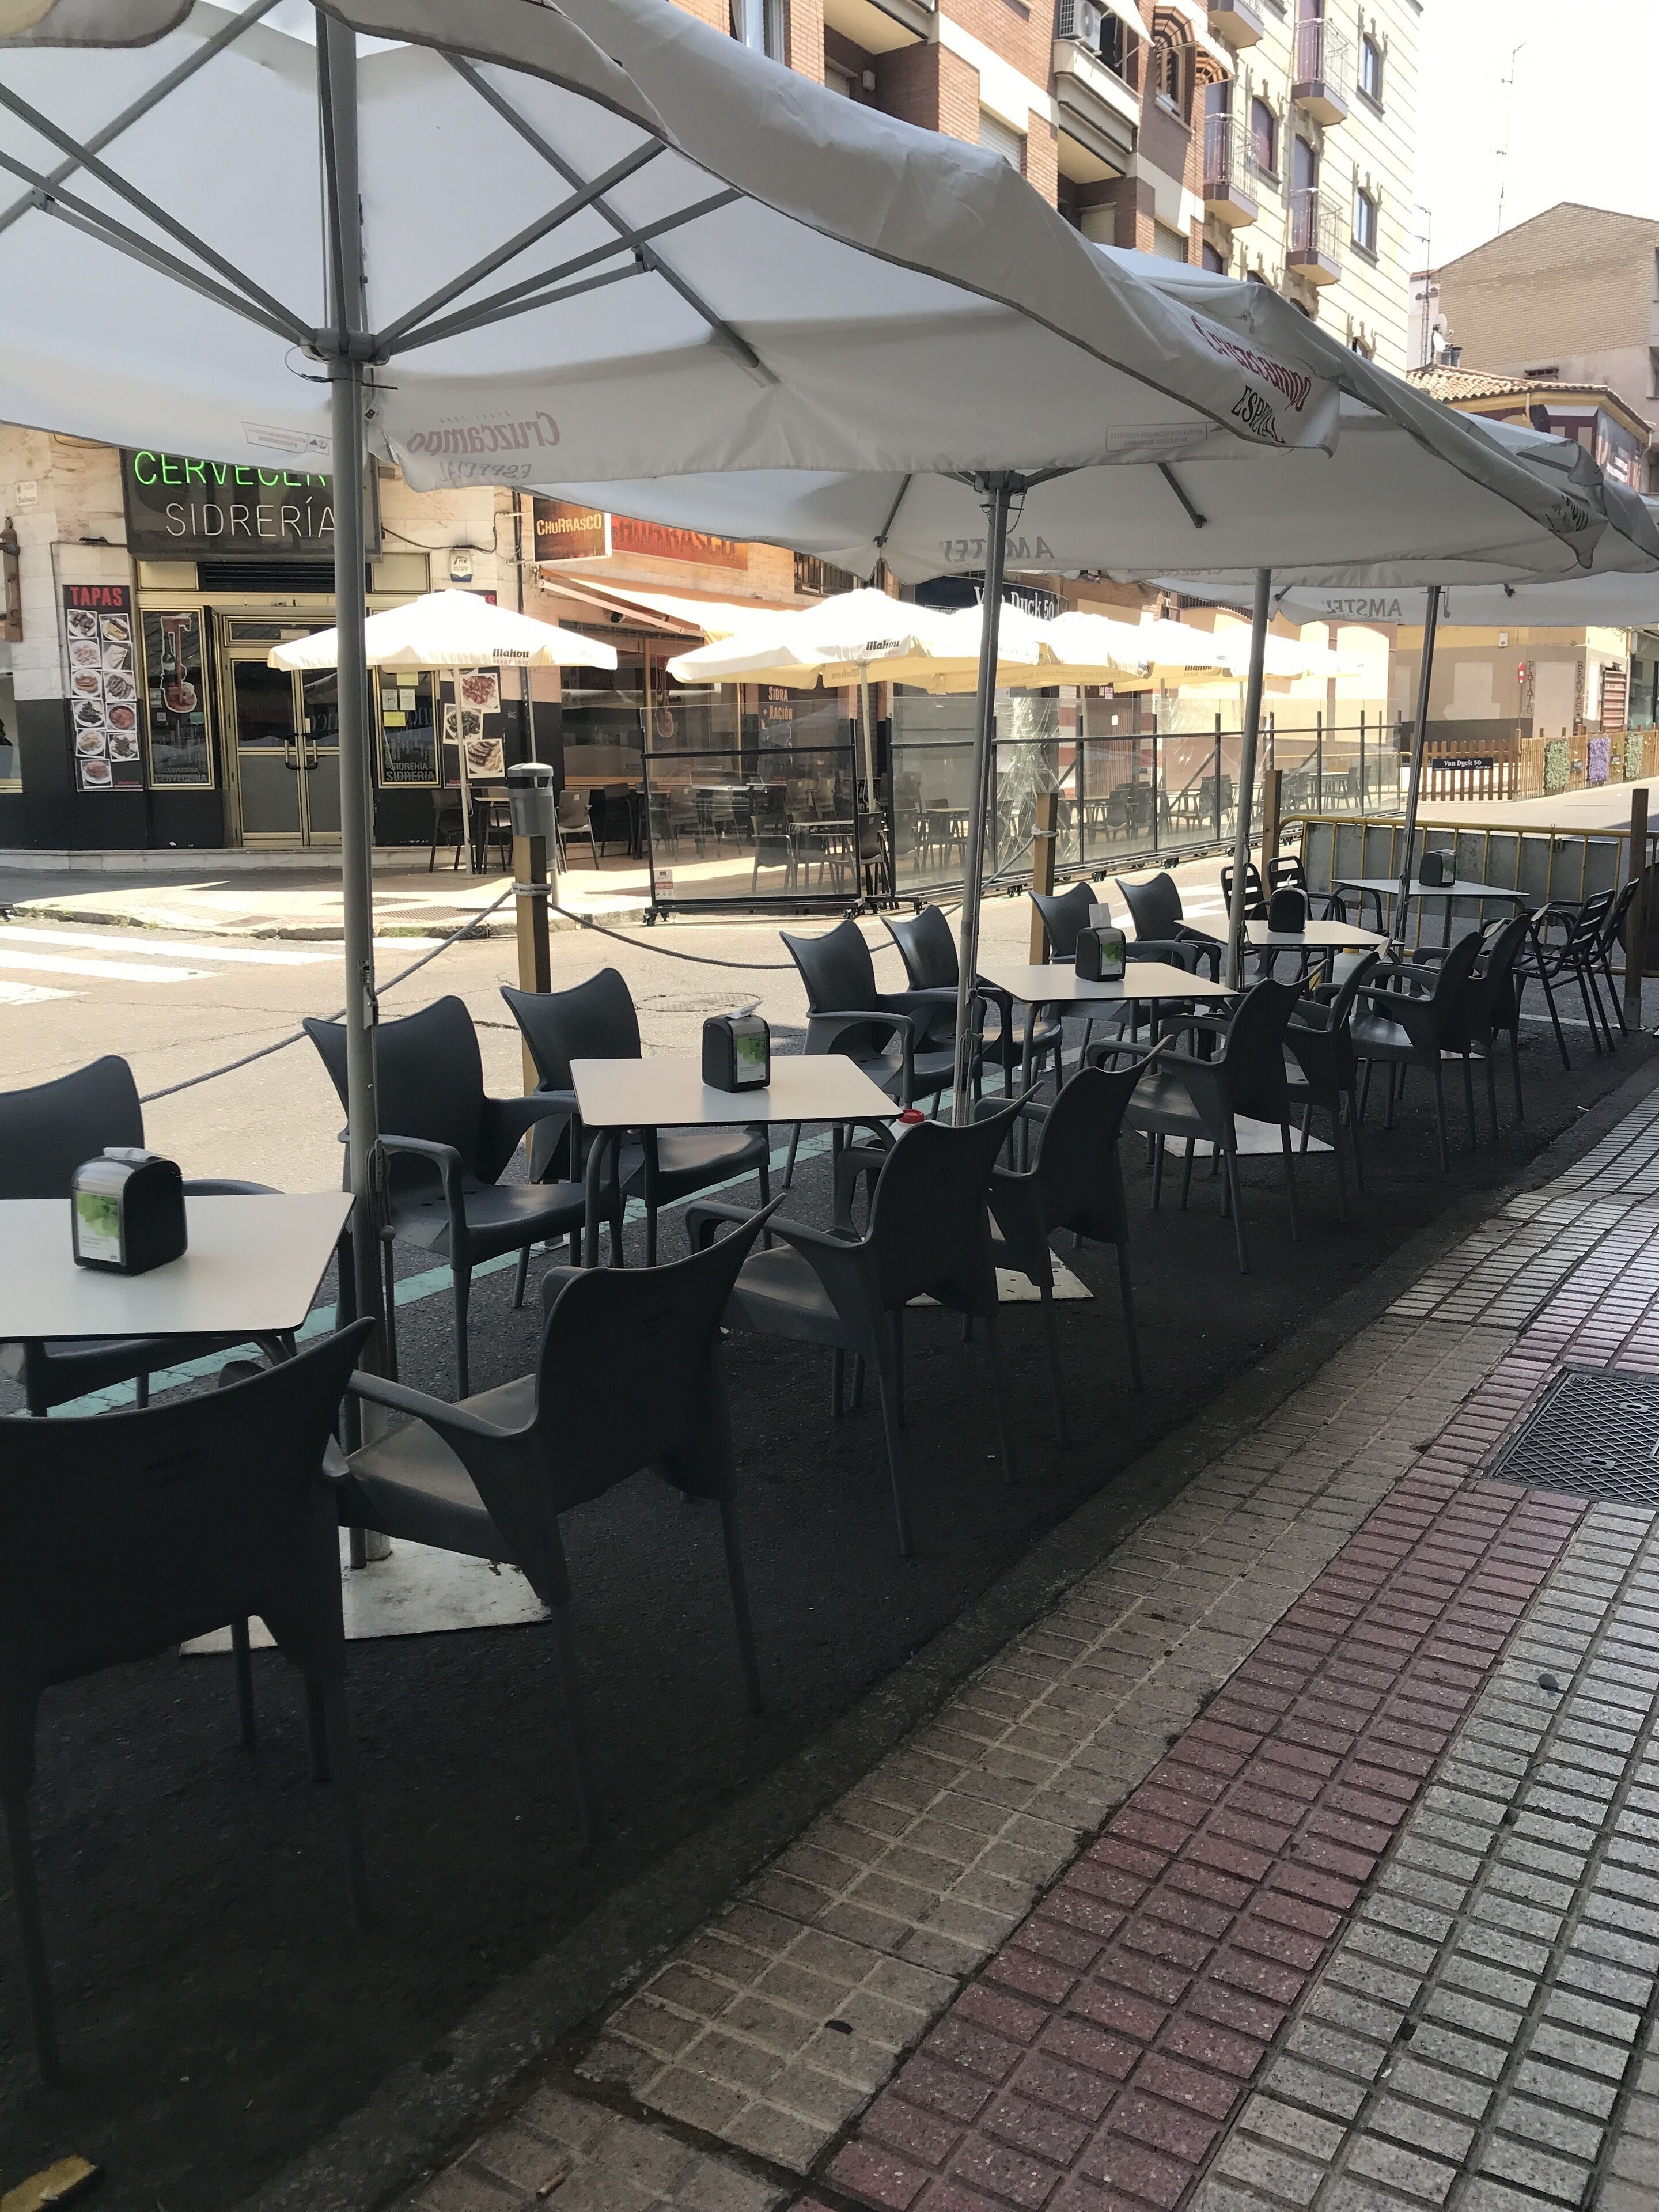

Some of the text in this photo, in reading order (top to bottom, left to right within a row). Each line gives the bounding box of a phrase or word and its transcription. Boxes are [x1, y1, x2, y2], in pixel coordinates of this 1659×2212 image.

[1190, 315, 1312, 412] Cruzcampo
[166, 496, 335, 537] SIDRERÍA
[536, 513, 601, 536] CHURRASCO
[70, 586, 123, 606] TAPAS
[1044, 599, 1054, 620] 50
[493, 648, 529, 658] Mahou
[866, 639, 900, 650] Mahou
[768, 686, 788, 701] SIDRA
[1527, 661, 1535, 718] PATATAS
[1457, 759, 1472, 767] Dyck
